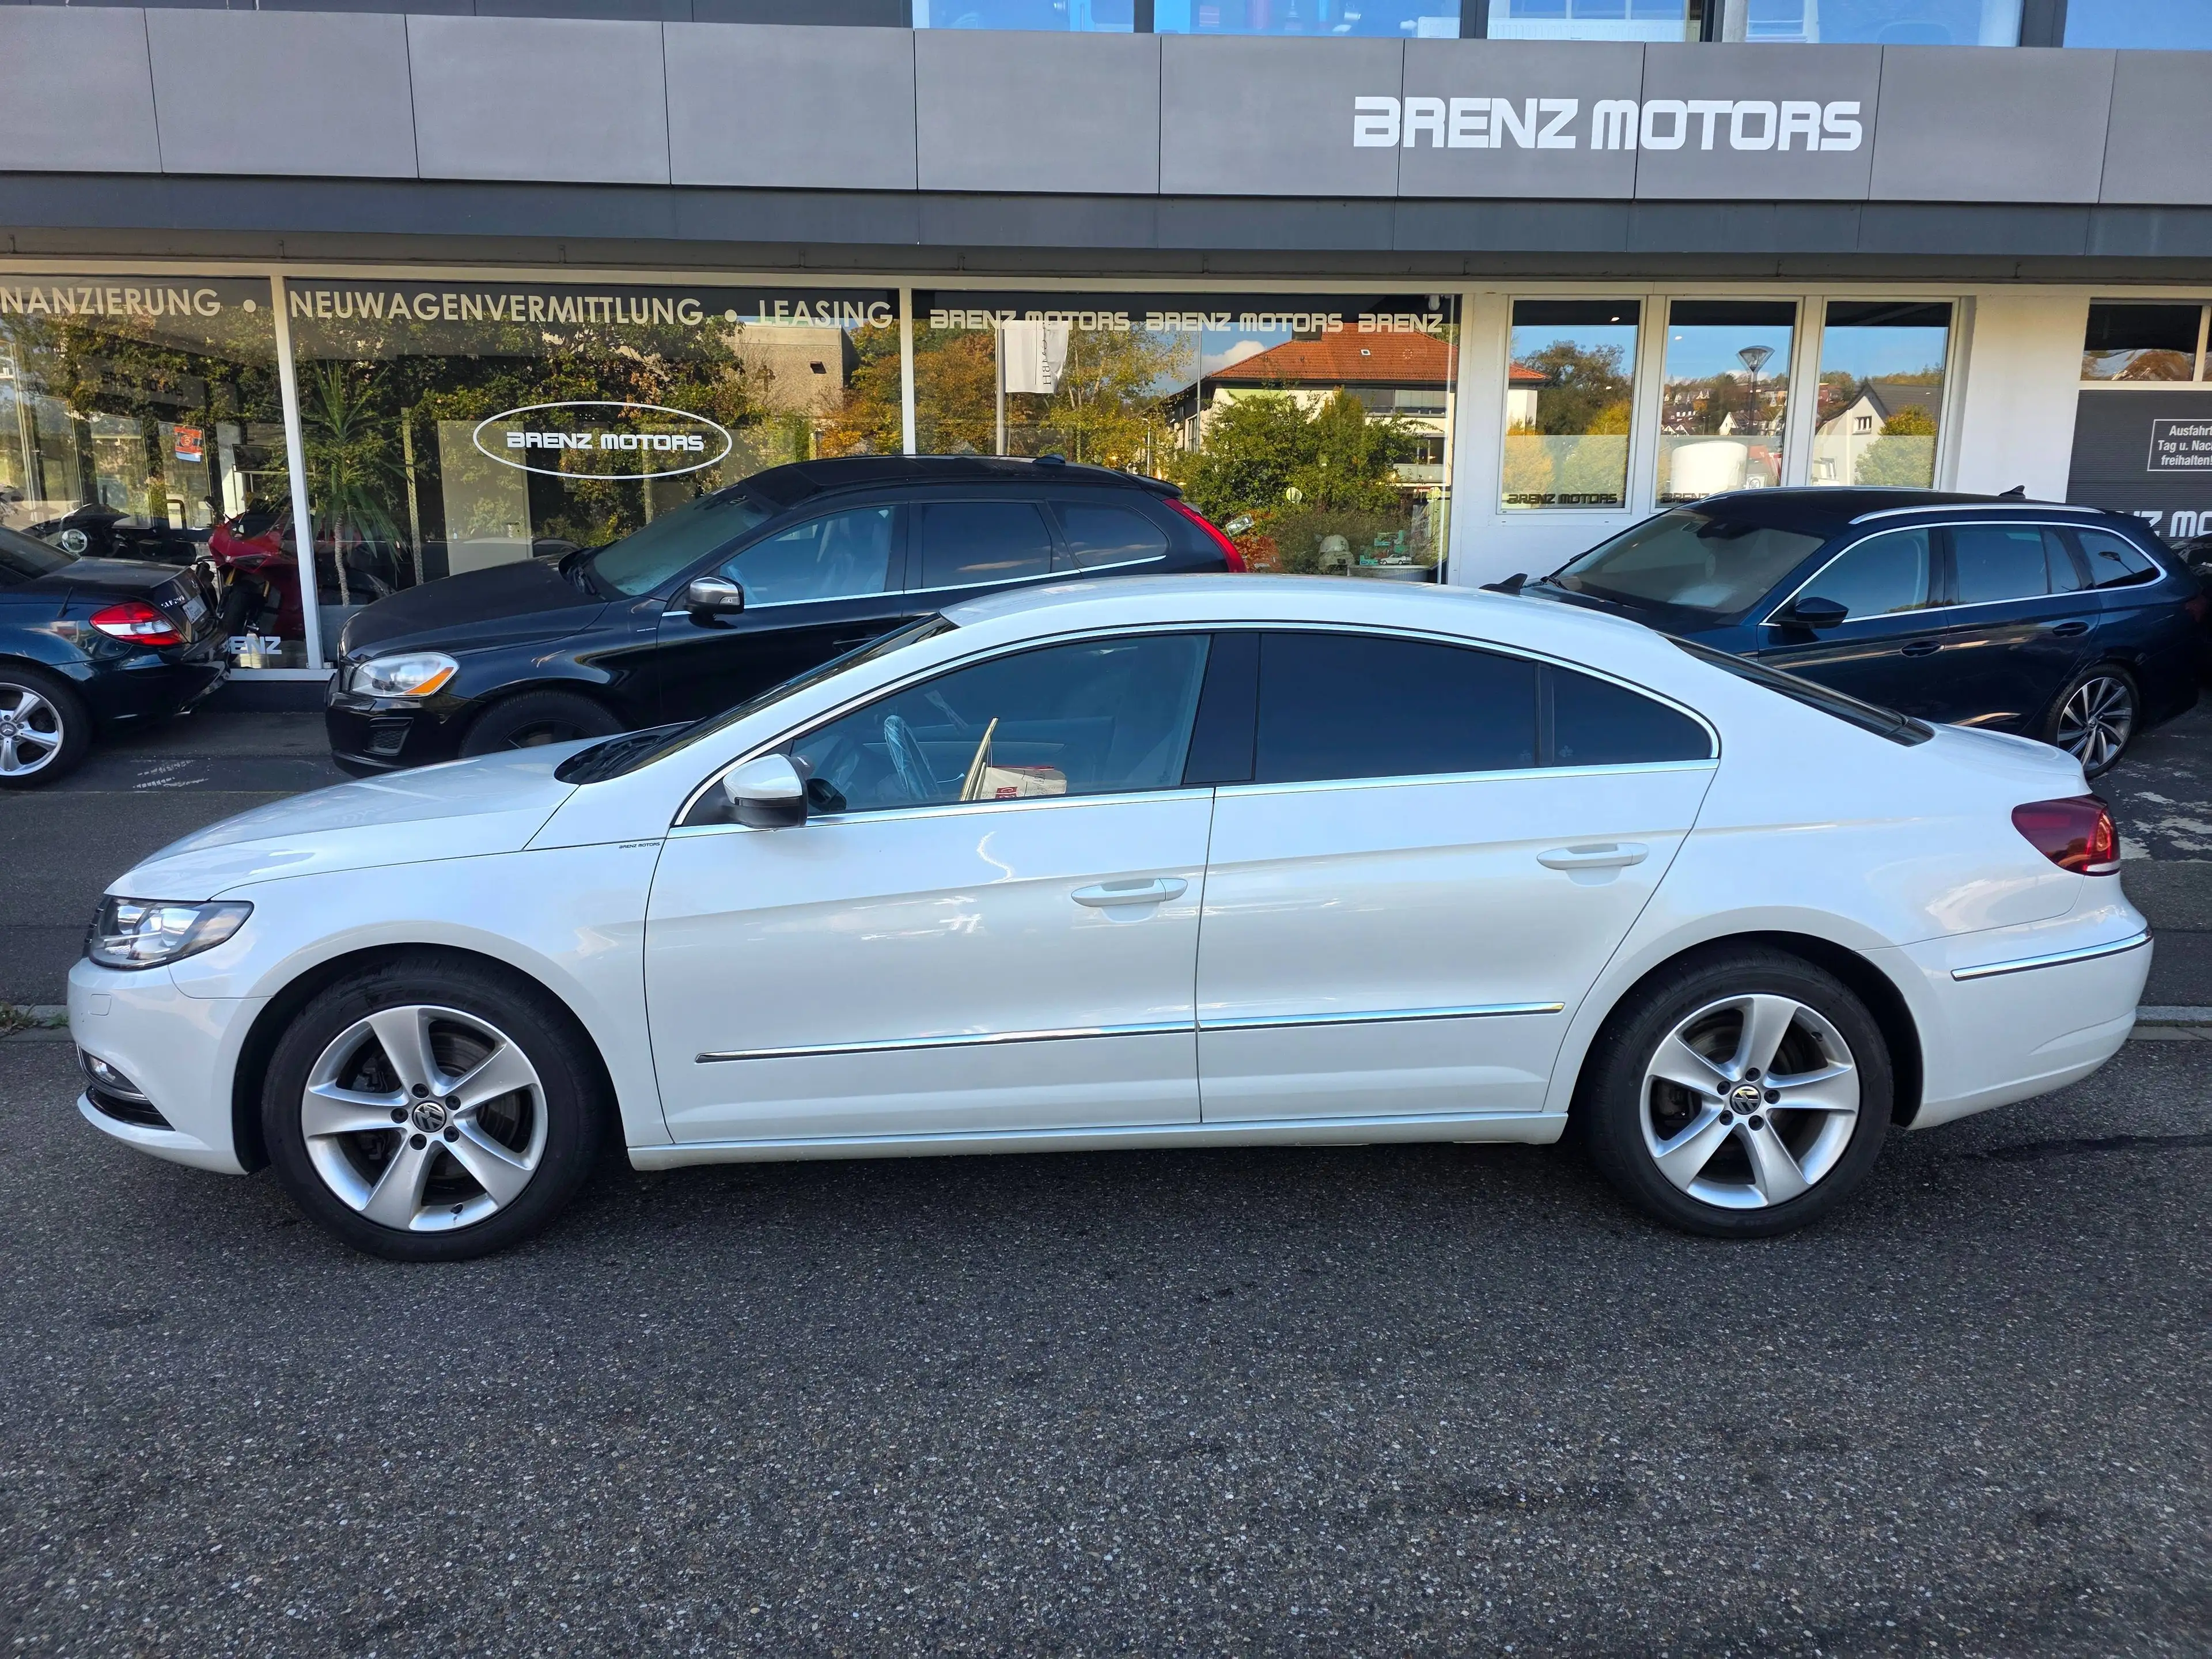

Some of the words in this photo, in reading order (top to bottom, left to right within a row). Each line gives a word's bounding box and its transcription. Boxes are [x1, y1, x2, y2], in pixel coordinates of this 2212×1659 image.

[1354, 96, 1578, 149] BRENZ
[1590, 99, 1862, 151] MOTORS
[0, 287, 221, 316] NANZIERUNG
[290, 290, 703, 325] NEUWAGENVERMITTLUNG
[759, 300, 893, 328] LEASING
[930, 309, 1017, 329] BRENZ
[1025, 310, 1130, 331] MOTORS
[1146, 311, 1232, 332] BRENZ
[1239, 312, 1343, 332] MOTORS
[1358, 313, 1443, 333] BRENZ
[2168, 425, 2212, 436] Ausfahrt
[506, 432, 593, 449] BRENZ
[601, 434, 704, 451] MOTORS
[2158, 440, 2176, 453] Tag
[2179, 442, 2188, 451] u.
[2191, 440, 2212, 451] Nac
[1507, 493, 1555, 504] BRENZ
[1558, 493, 1618, 504] MOTORS
[230, 636, 282, 655] ENZ
